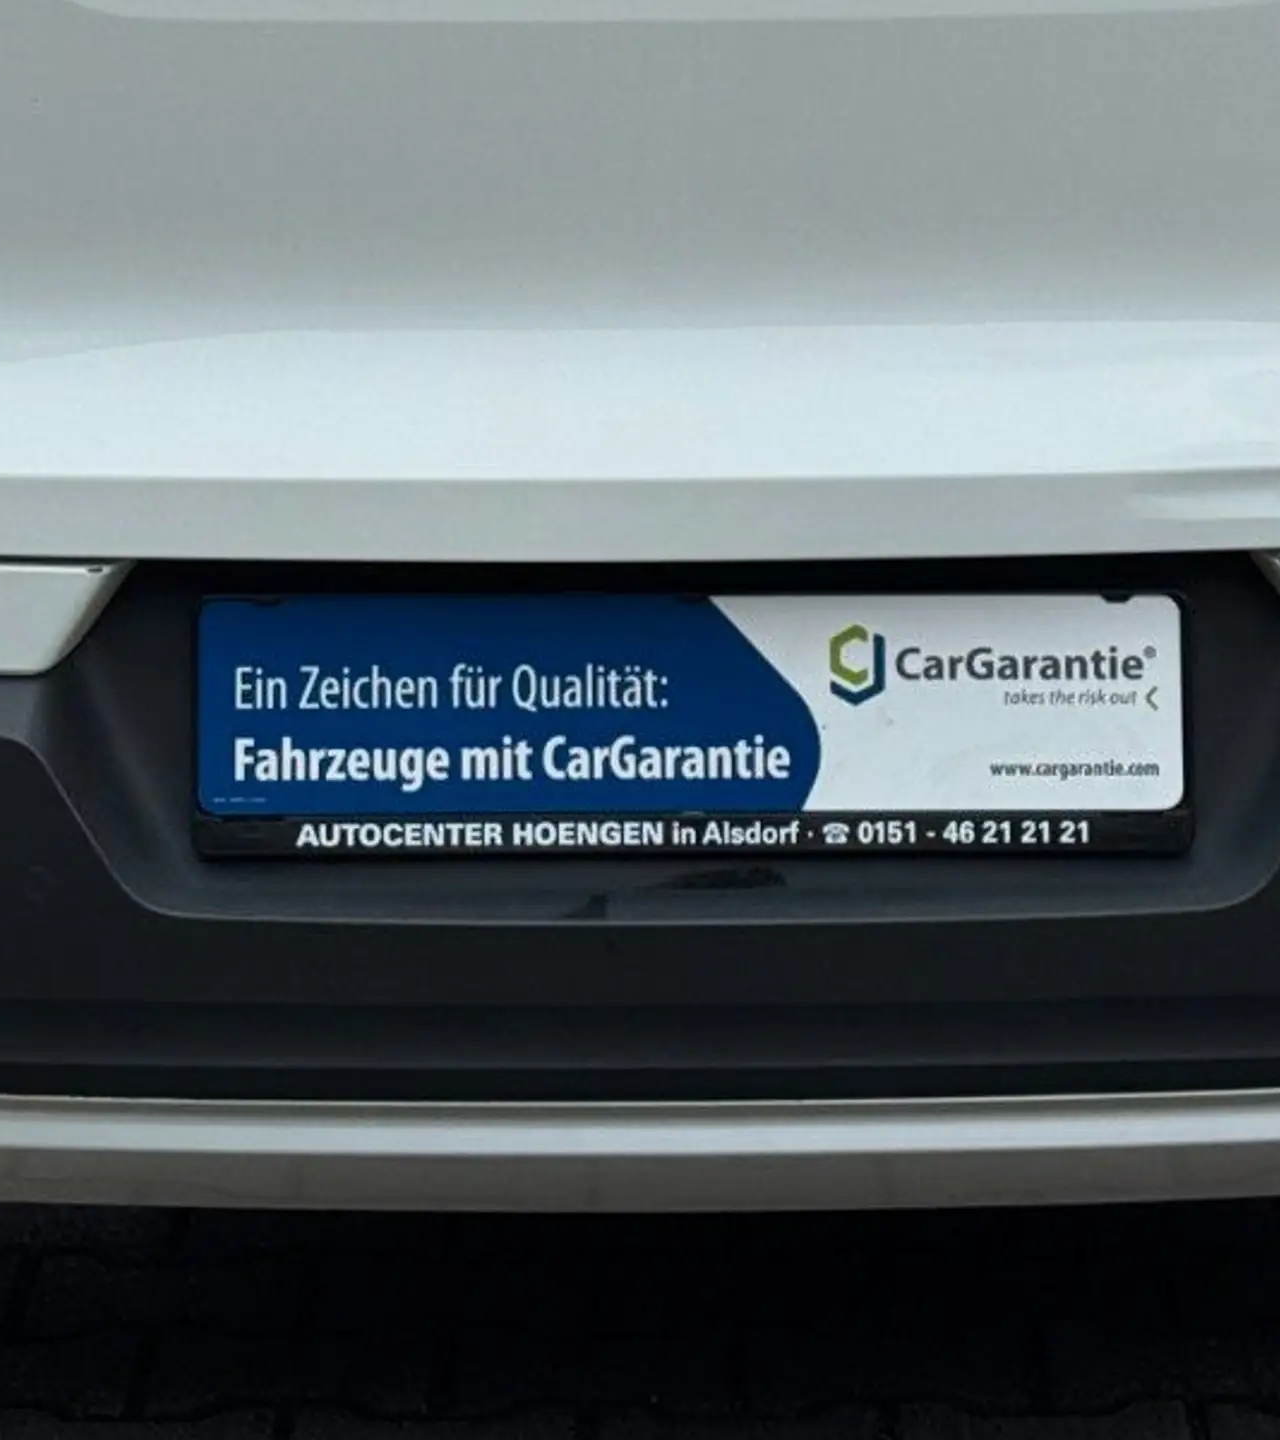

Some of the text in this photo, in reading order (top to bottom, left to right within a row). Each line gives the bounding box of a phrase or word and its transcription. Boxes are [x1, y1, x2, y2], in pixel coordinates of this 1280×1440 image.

[234, 663, 669, 712] Ein Zeichen für Qualität:
[1004, 690, 1137, 705] takes the risk out
[234, 734, 791, 793] Fahrzeuge mit CarGarantie
[990, 760, 1160, 780] www.cargarantie.com
[295, 823, 503, 848] AUTOCENTER
[512, 822, 663, 847] HOENGEN
[672, 821, 696, 846] in
[702, 820, 800, 846] Alsdorf
[857, 820, 917, 844] 0151
[942, 819, 975, 843] 46
[981, 819, 1012, 843] 21
[1020, 819, 1051, 843] 21
[1059, 819, 1090, 843] 21
